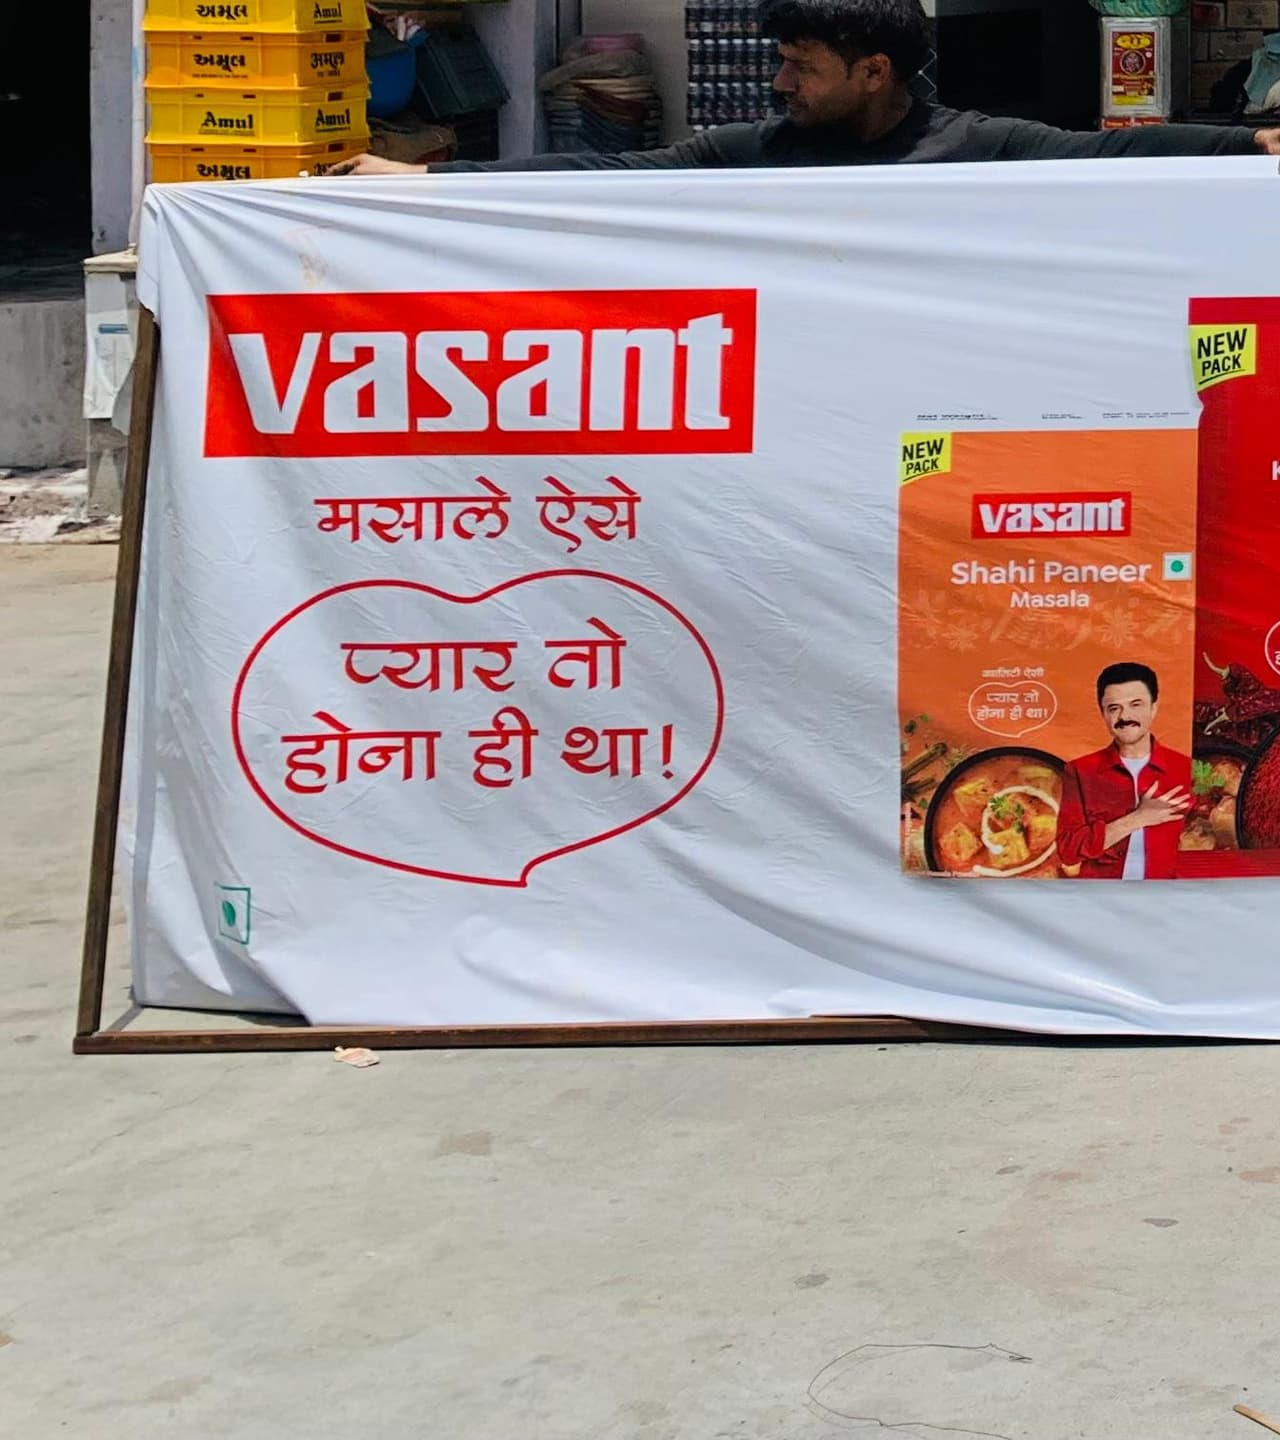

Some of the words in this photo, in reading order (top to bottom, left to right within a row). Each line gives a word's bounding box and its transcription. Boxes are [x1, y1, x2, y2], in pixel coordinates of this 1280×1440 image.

[195, 3, 249, 21] અમૂલ
[313, 1, 343, 20] Amul
[193, 52, 247, 73] અમૂલ
[200, 110, 254, 131] Amul
[314, 108, 352, 128] Amul
[1197, 327, 1248, 360] NEW
[1201, 353, 1243, 377] PACK
[901, 437, 945, 462] NEW
[904, 457, 941, 476] PACK
[313, 476, 513, 545] मसाले
[535, 475, 641, 553] ऐसे
[950, 557, 1036, 587] Shahi
[1043, 559, 1153, 585] Paneer
[1009, 589, 1091, 609] Masala
[340, 640, 518, 692] प्यार
[544, 616, 628, 691] तो
[1023, 688, 1040, 704] तो
[975, 704, 1006, 721] होना
[281, 710, 442, 795] होना
[468, 705, 540, 789] ही
[560, 723, 675, 781] था!
